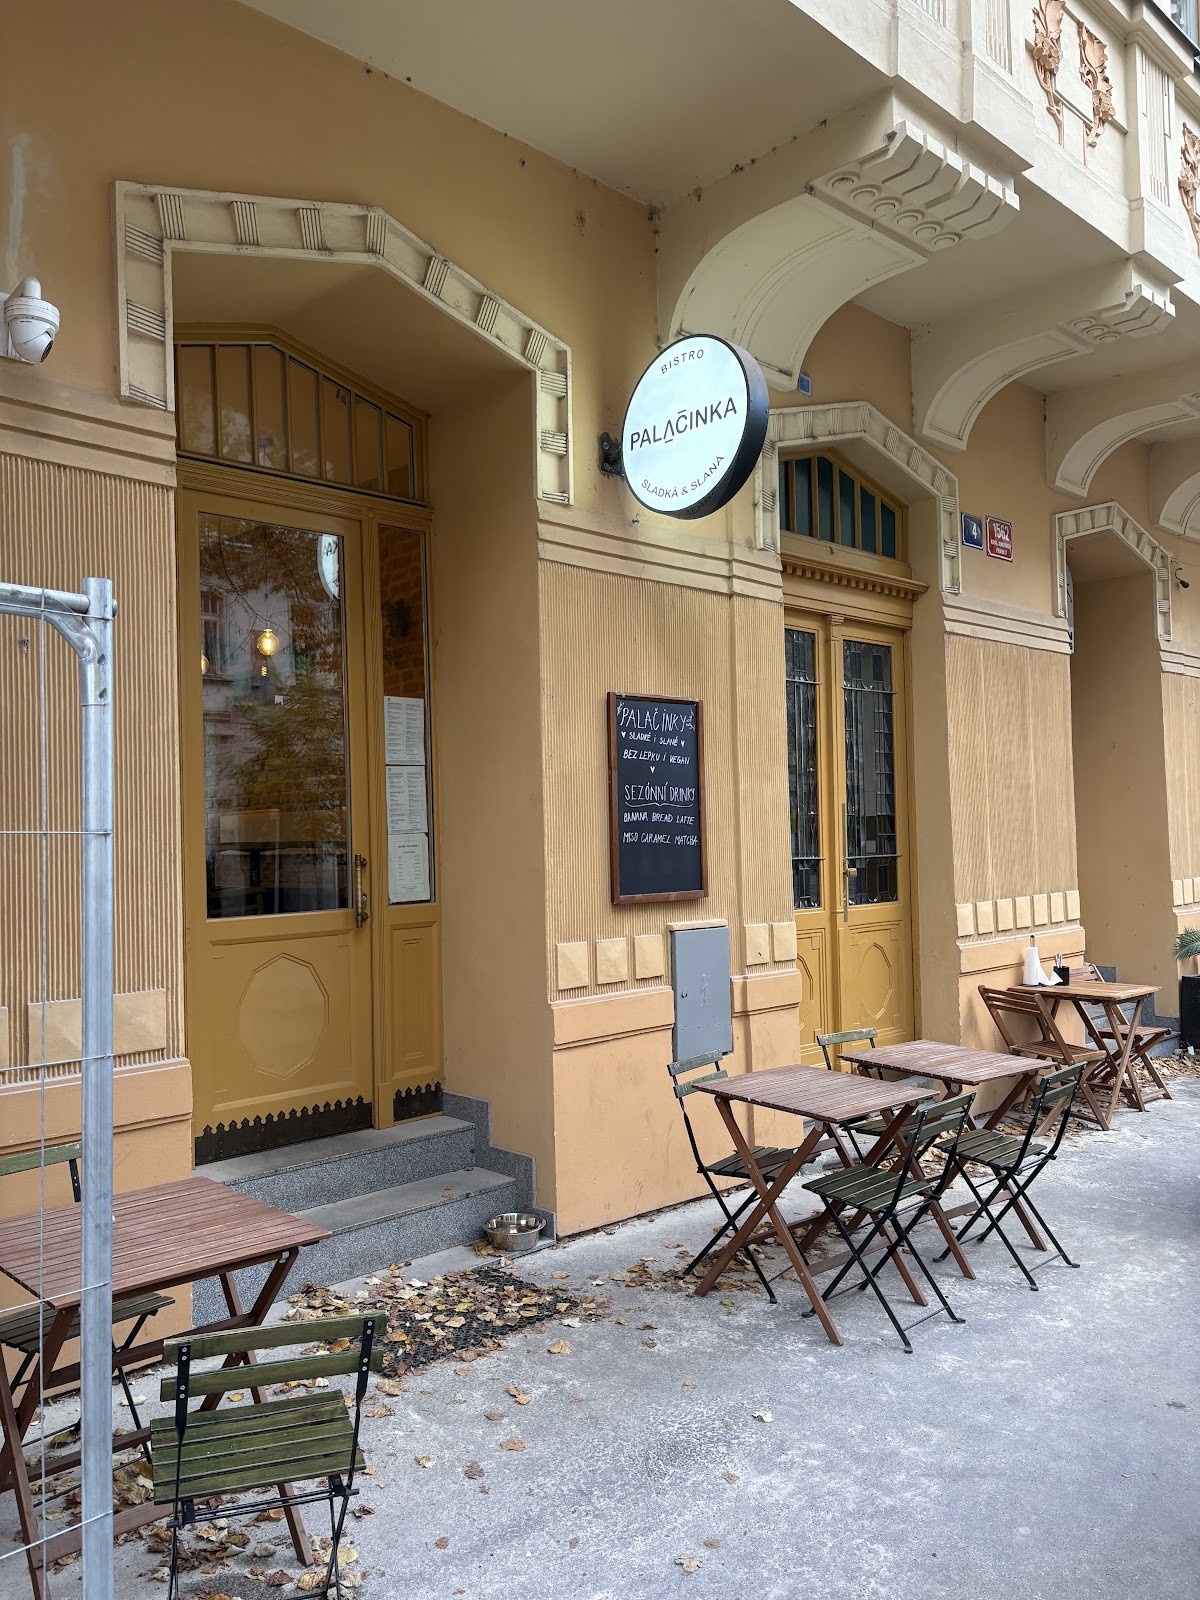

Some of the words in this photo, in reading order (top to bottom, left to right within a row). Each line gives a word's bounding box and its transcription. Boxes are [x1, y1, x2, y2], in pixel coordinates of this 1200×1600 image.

[661, 349, 705, 374] BISTRO
[630, 397, 737, 451] PALAČINKA
[641, 479, 678, 498] SLADKÁ
[681, 486, 689, 496] &
[690, 455, 725, 492] SLANÁ
[972, 522, 978, 540] 4
[992, 522, 1010, 541] 1562
[623, 749, 639, 760] BEZ
[640, 750, 661, 762] LEPKU
[669, 755, 691, 766] VEGAN
[623, 811, 649, 823] BANANA
[651, 812, 673, 823] BREAD
[676, 815, 696, 826] LATTE
[623, 831, 639, 843] MISO
[640, 832, 671, 844] CARAMEL
[674, 834, 699, 847] MATCHA
